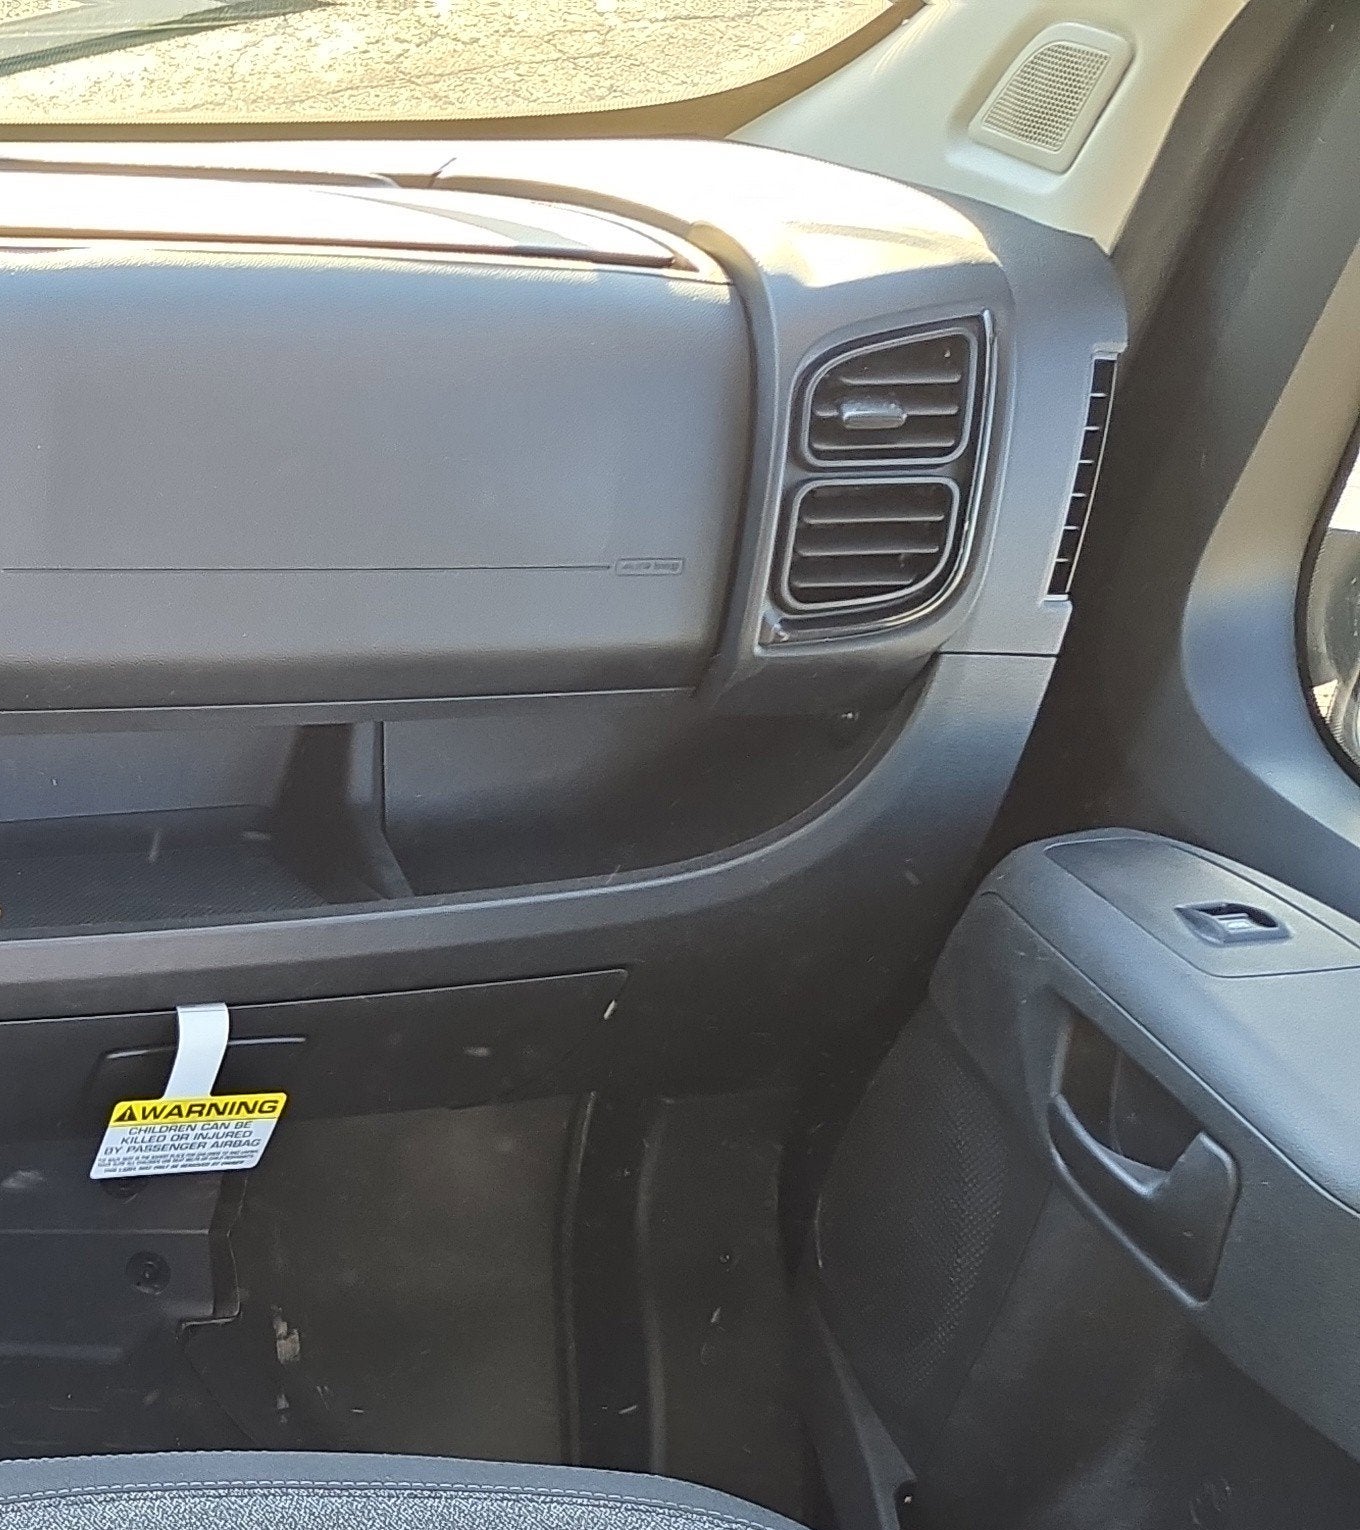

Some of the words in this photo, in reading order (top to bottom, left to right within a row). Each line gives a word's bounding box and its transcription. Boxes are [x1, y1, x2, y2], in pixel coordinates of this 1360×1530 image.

[141, 1100, 279, 1120] WARNING
[128, 1123, 197, 1135] CHILDREN
[200, 1122, 233, 1131] CAN
[234, 1120, 253, 1130] BE
[120, 1134, 167, 1145] KILLED
[170, 1133, 190, 1143] OR
[193, 1130, 254, 1141] INJURED
[104, 1146, 123, 1155] BY
[126, 1141, 208, 1153] PASSENGER
[210, 1138, 262, 1149] AIRBAG
